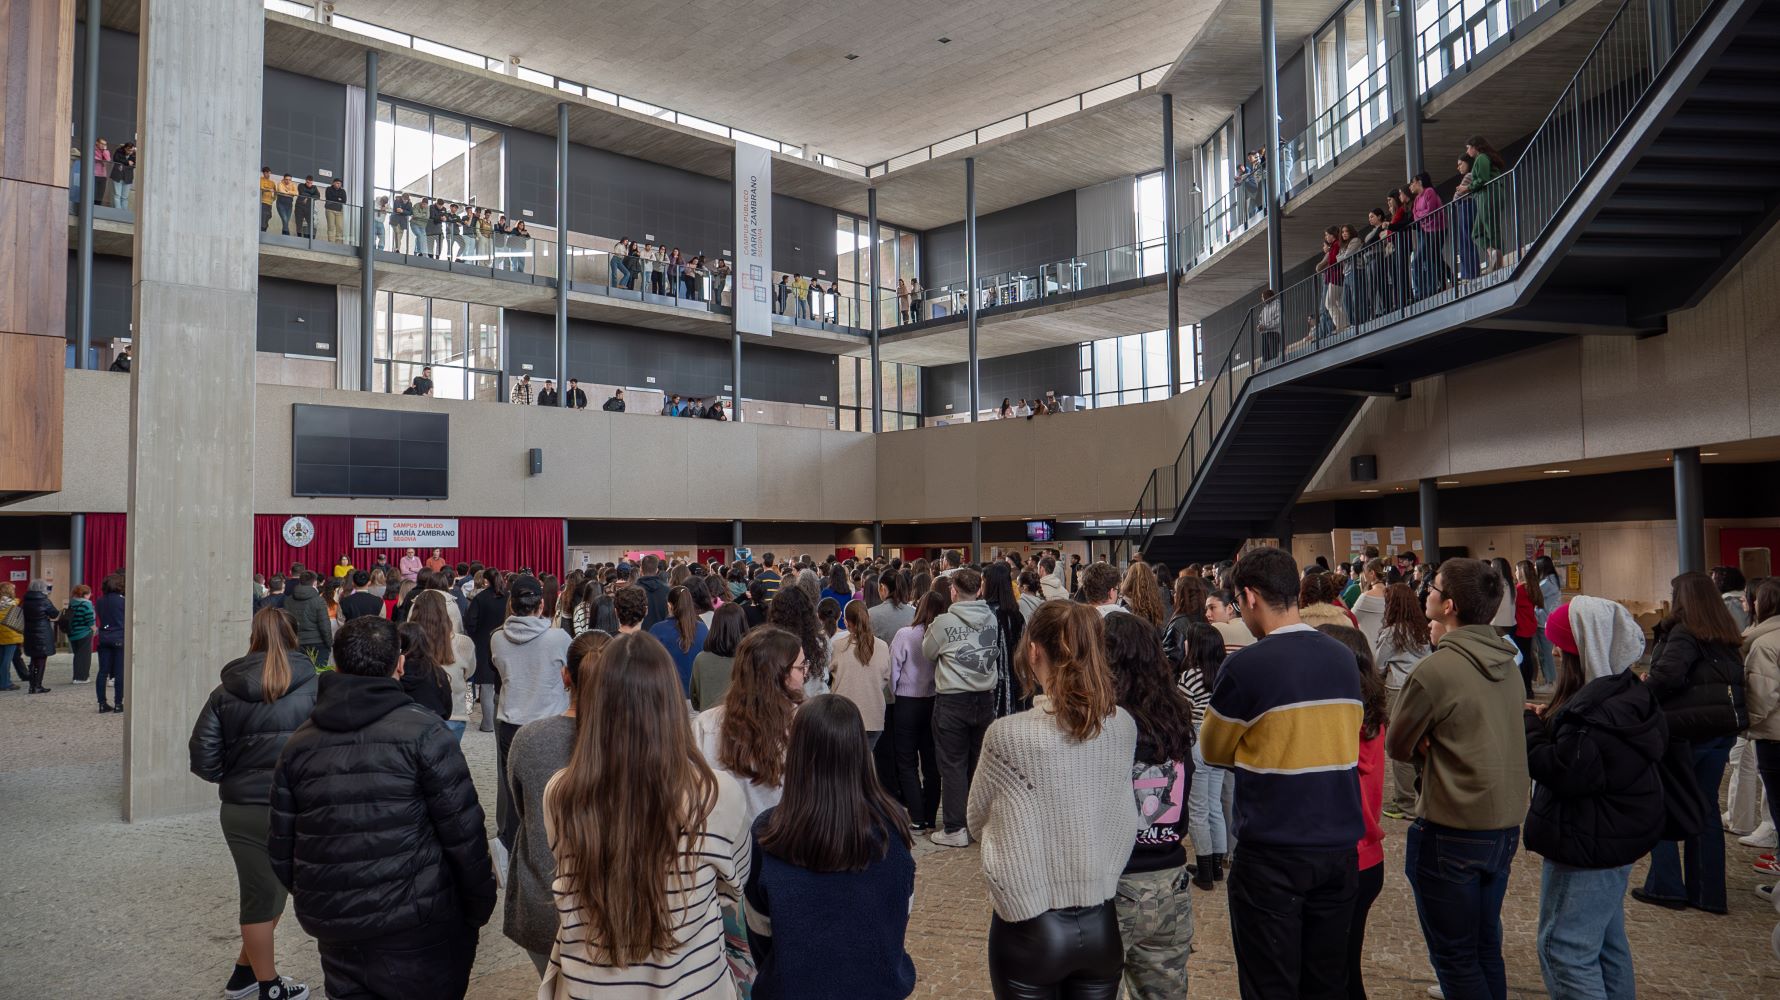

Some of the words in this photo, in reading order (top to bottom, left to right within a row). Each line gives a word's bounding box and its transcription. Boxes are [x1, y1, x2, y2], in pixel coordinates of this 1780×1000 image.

[393, 528, 416, 537] MARÍA
[417, 529, 455, 537] ZAMBRANO
[947, 633, 968, 643] DAY
